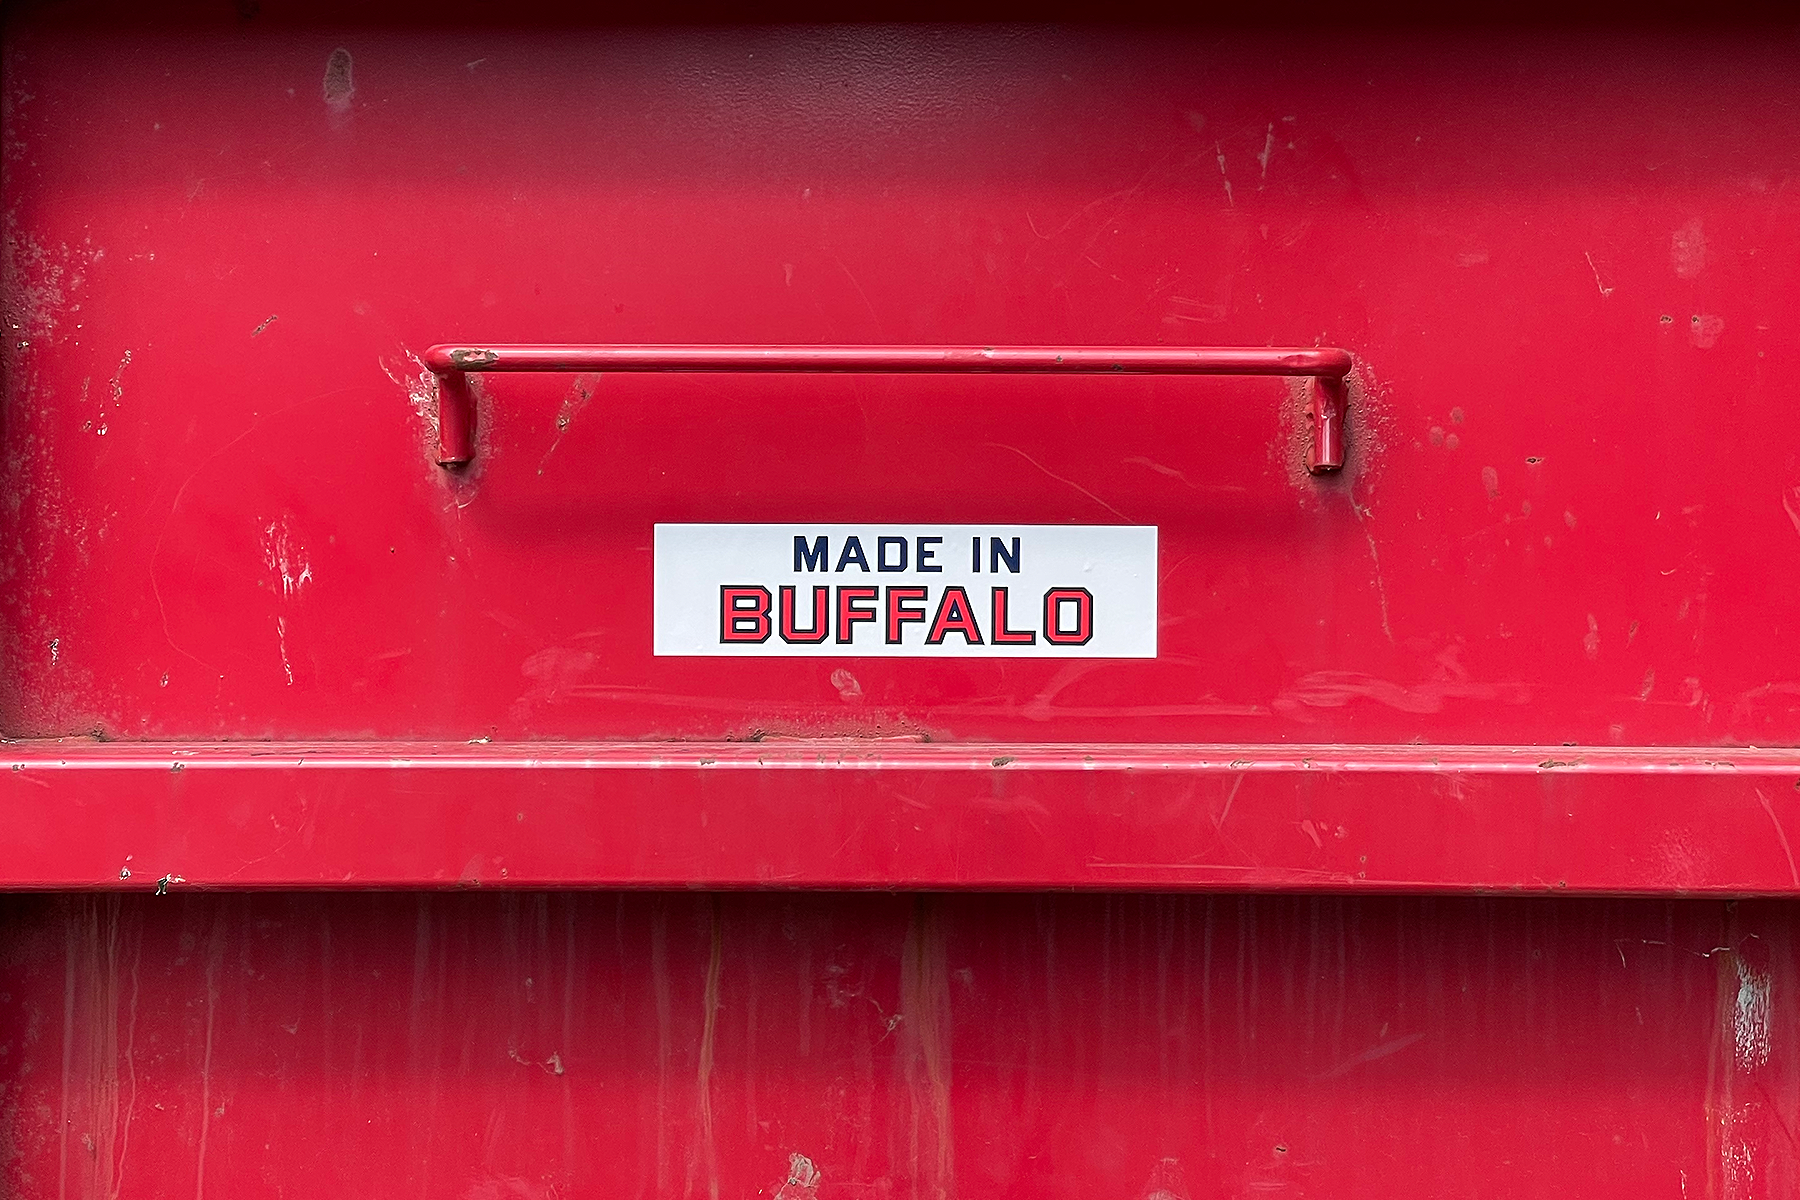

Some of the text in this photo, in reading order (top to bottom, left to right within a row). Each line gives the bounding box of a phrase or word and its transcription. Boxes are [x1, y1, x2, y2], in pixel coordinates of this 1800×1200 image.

[793, 536, 1021, 574] MADE IN
[719, 584, 1094, 647] BUFFALO
